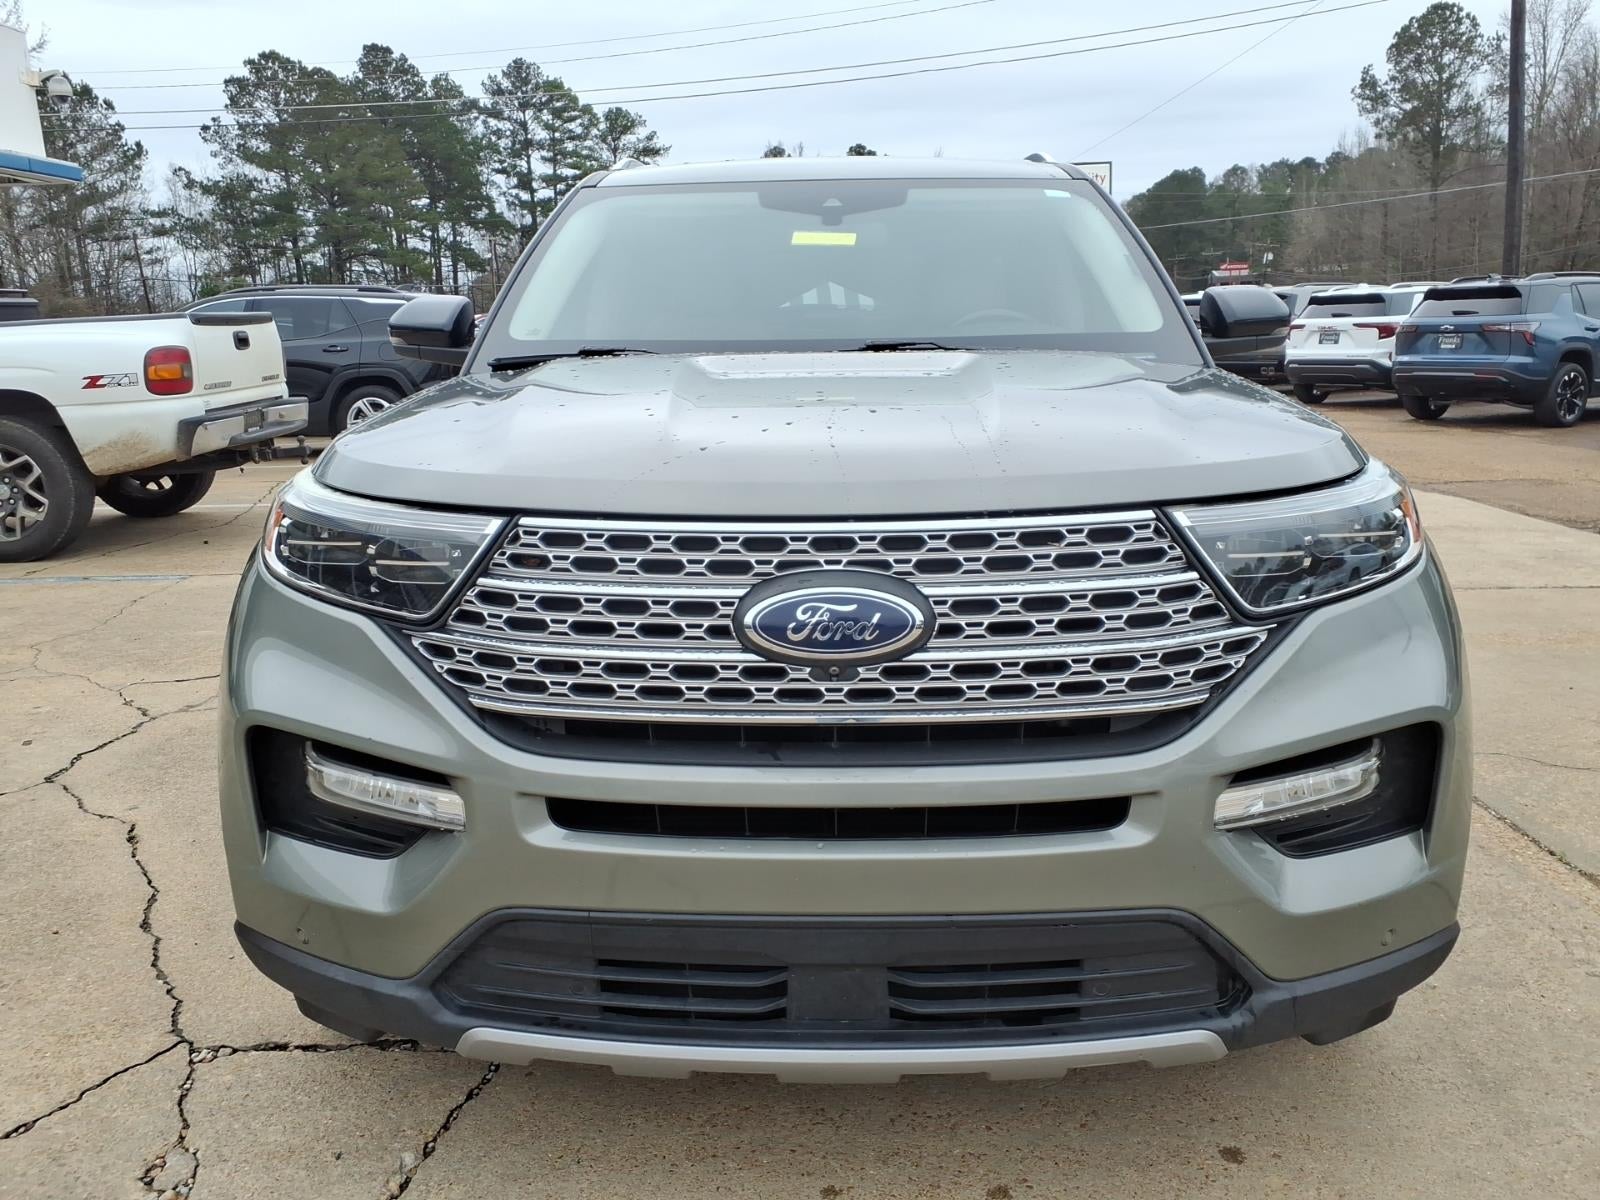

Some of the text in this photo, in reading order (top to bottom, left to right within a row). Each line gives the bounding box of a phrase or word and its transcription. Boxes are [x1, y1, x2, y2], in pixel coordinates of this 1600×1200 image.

[1088, 172, 1106, 185] ity
[81, 373, 138, 389] Z71
[786, 602, 881, 641] Ford
